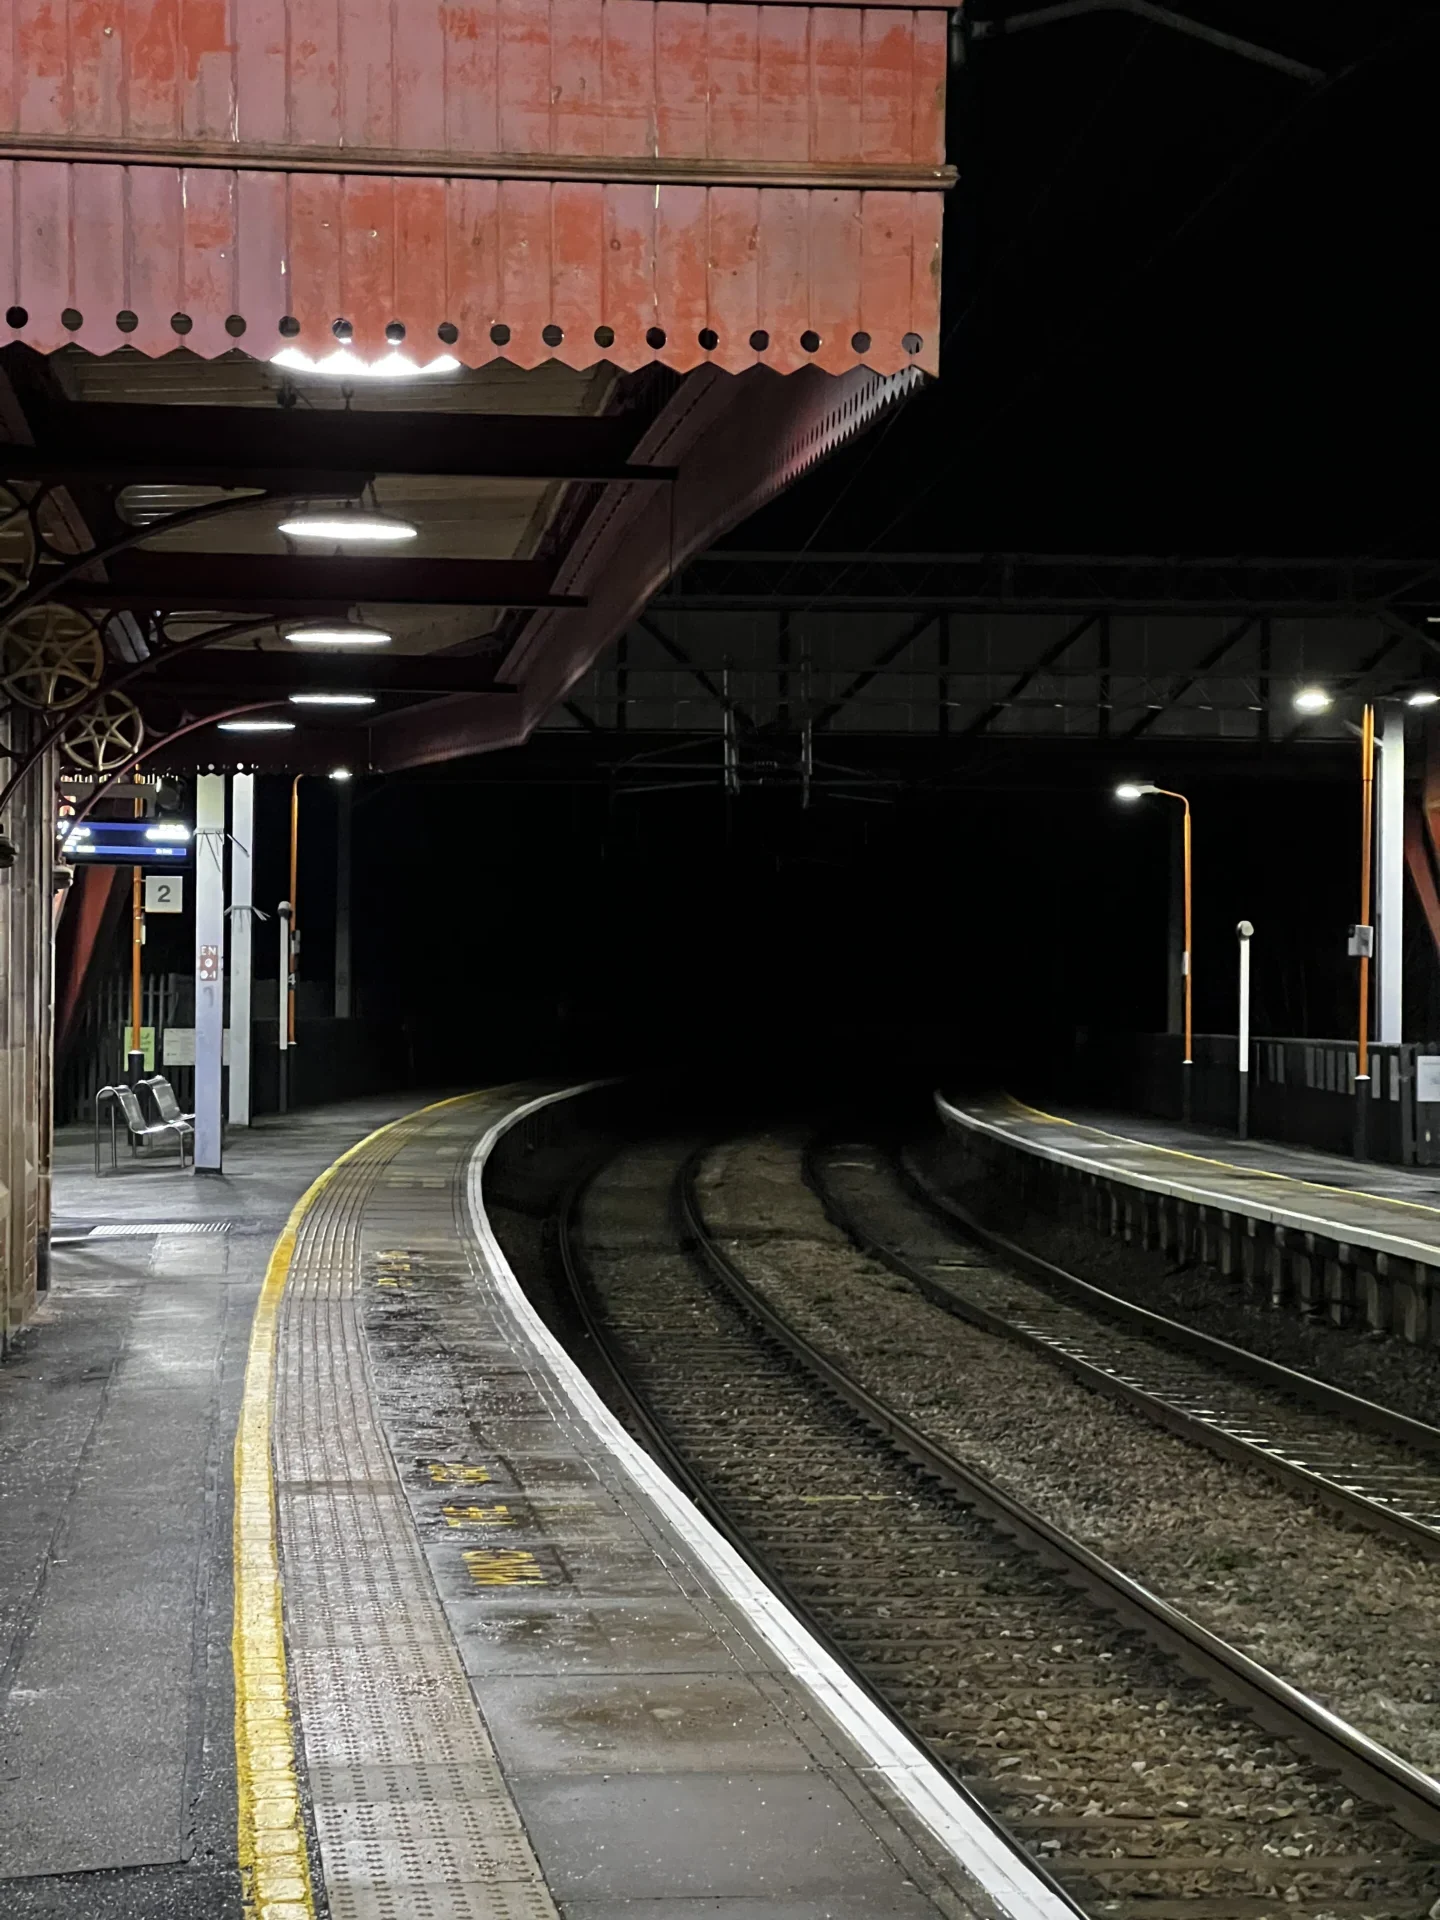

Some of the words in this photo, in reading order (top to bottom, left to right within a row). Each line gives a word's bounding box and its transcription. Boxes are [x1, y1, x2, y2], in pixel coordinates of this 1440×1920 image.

[157, 885, 171, 903] 2
[201, 946, 217, 956] EN
[442, 1504, 518, 1528] THE
[461, 1549, 548, 1586] MIND
